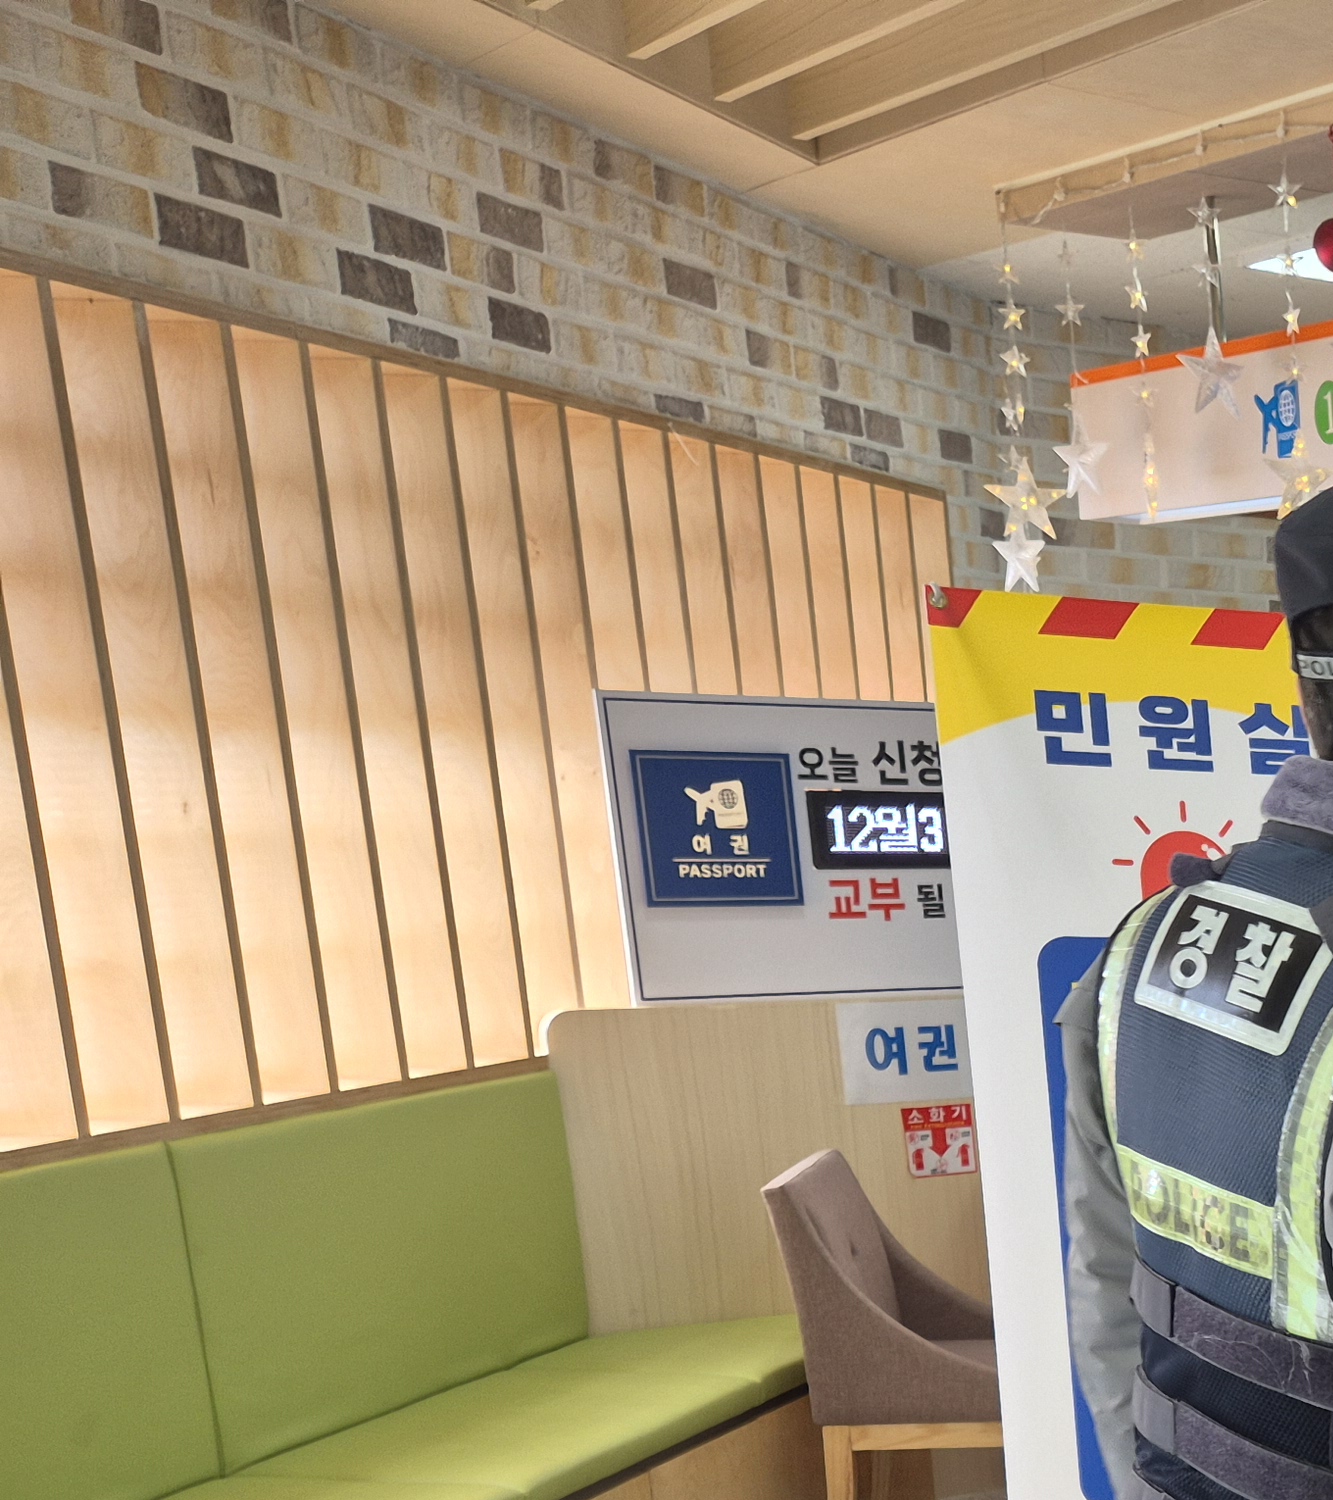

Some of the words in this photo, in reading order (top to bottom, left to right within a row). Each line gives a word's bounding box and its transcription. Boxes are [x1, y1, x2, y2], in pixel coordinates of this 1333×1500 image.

[798, 746, 859, 783] 오늘
[678, 864, 767, 879] PASSPORT
[829, 877, 906, 921] 교부
[917, 883, 946, 918] 될
[1167, 905, 1296, 1015] 경찰
[864, 1024, 958, 1076] 여권
